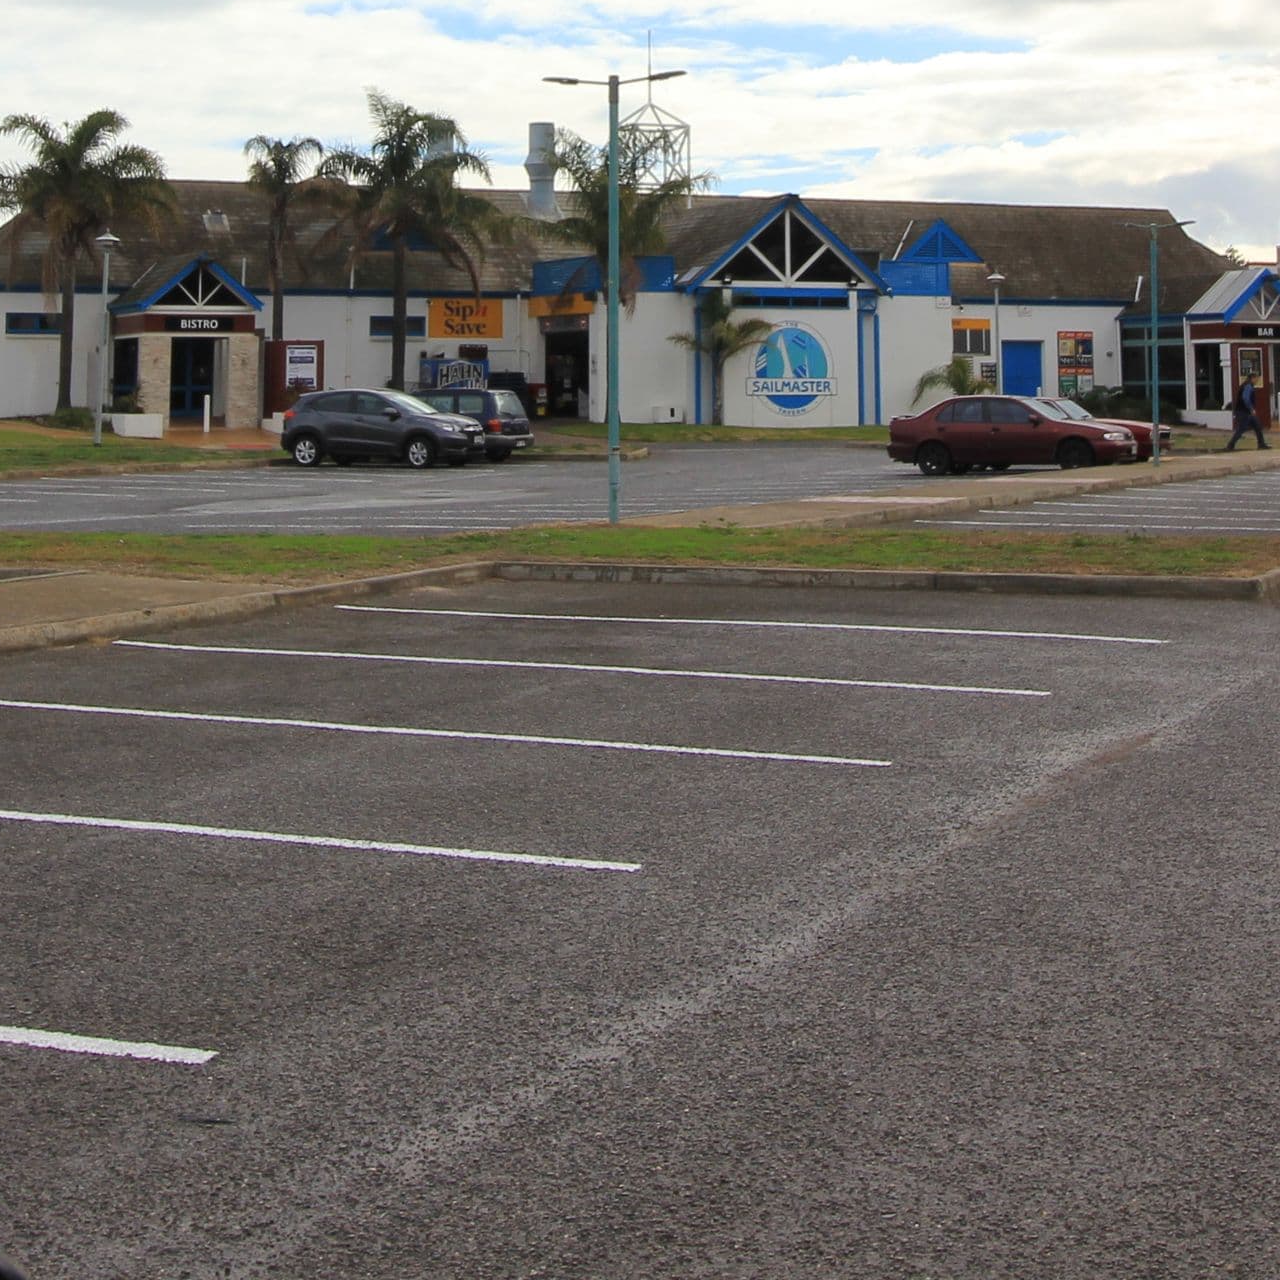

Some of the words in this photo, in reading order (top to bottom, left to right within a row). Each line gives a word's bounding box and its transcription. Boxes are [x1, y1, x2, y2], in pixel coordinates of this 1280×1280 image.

[180, 319, 219, 329] BISTRO
[444, 319, 487, 335] Save
[1257, 327, 1274, 337] BAR
[439, 363, 483, 385] HAHN
[752, 381, 831, 393] SAILMASTER
[778, 407, 808, 416] TAVERN
